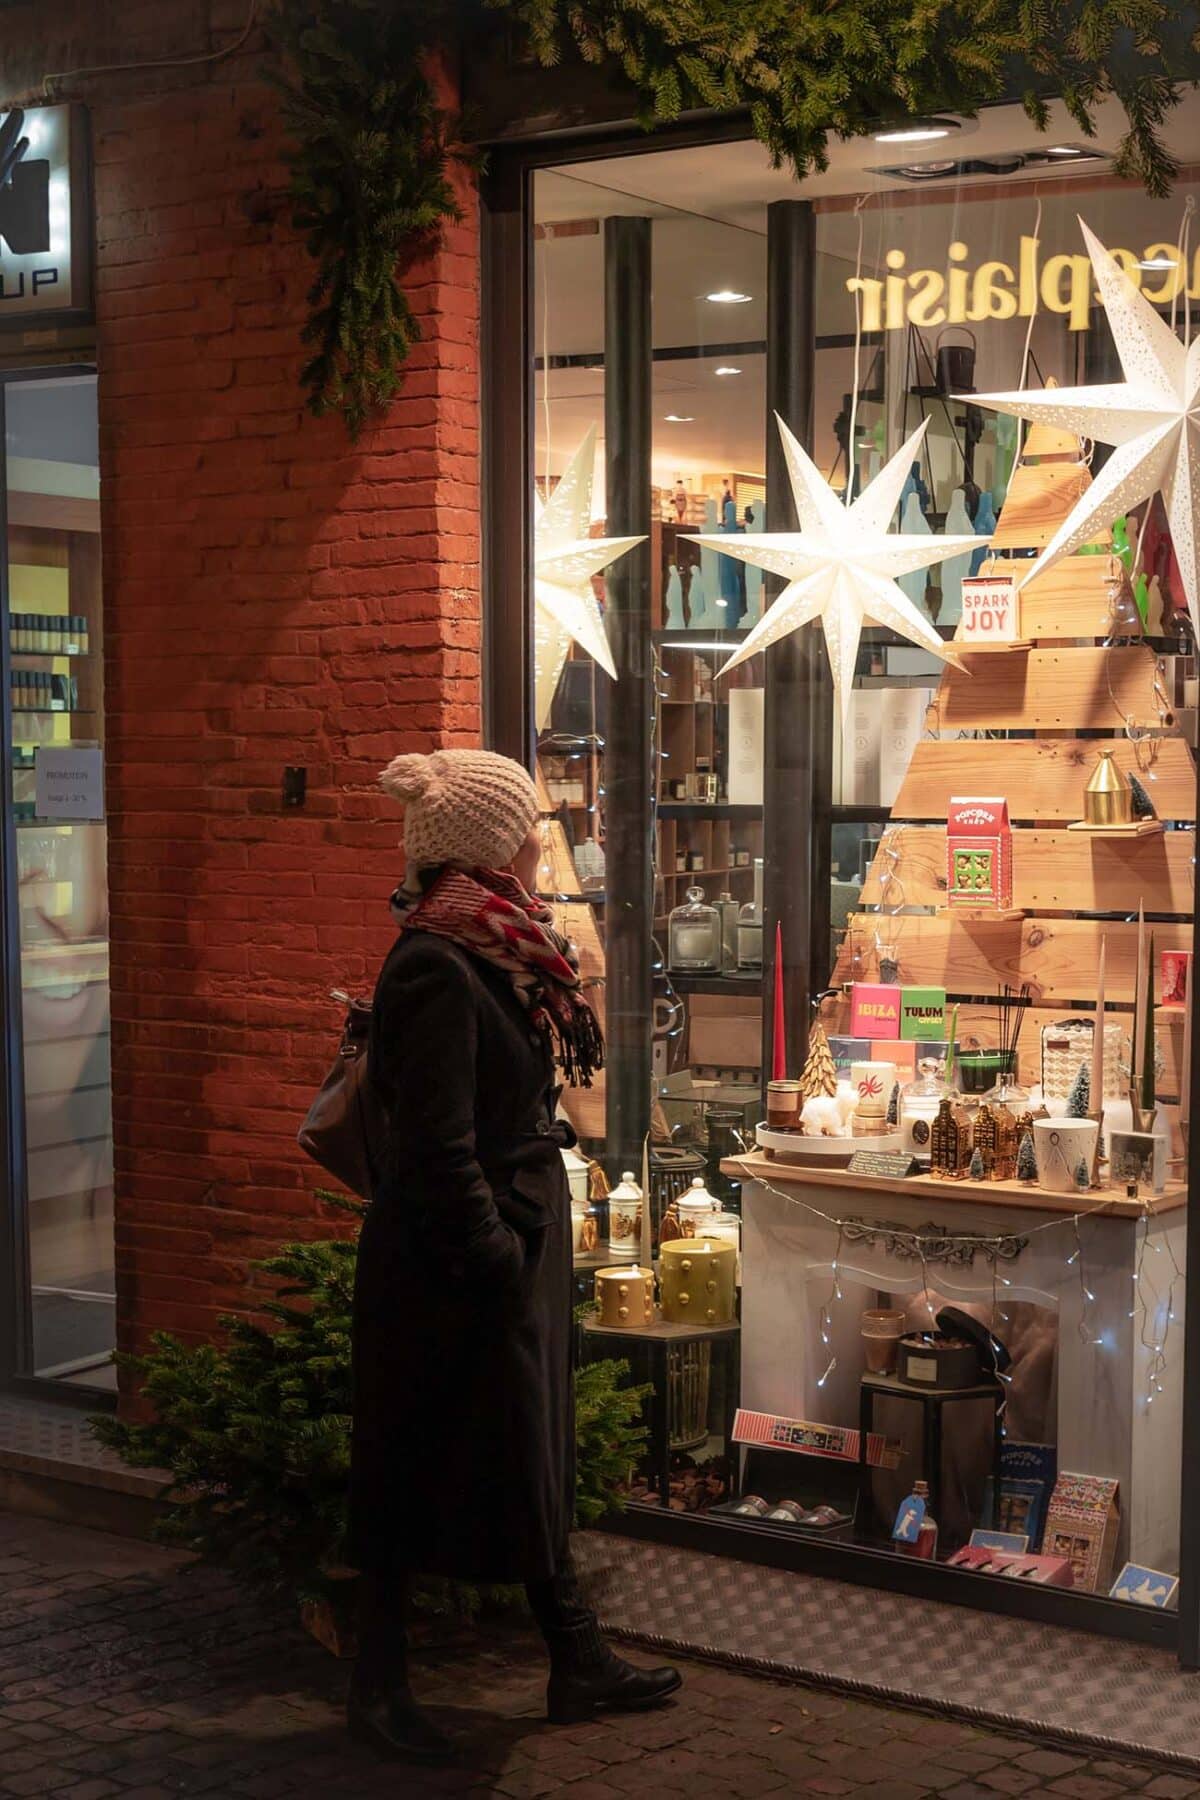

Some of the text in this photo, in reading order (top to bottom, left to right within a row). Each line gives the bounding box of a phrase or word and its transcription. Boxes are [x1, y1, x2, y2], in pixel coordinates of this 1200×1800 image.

[965, 594, 1009, 608] SPARK
[966, 610, 1006, 631] JOY
[858, 1003, 897, 1018] IBIZA
[904, 1006, 943, 1017] TULUM
